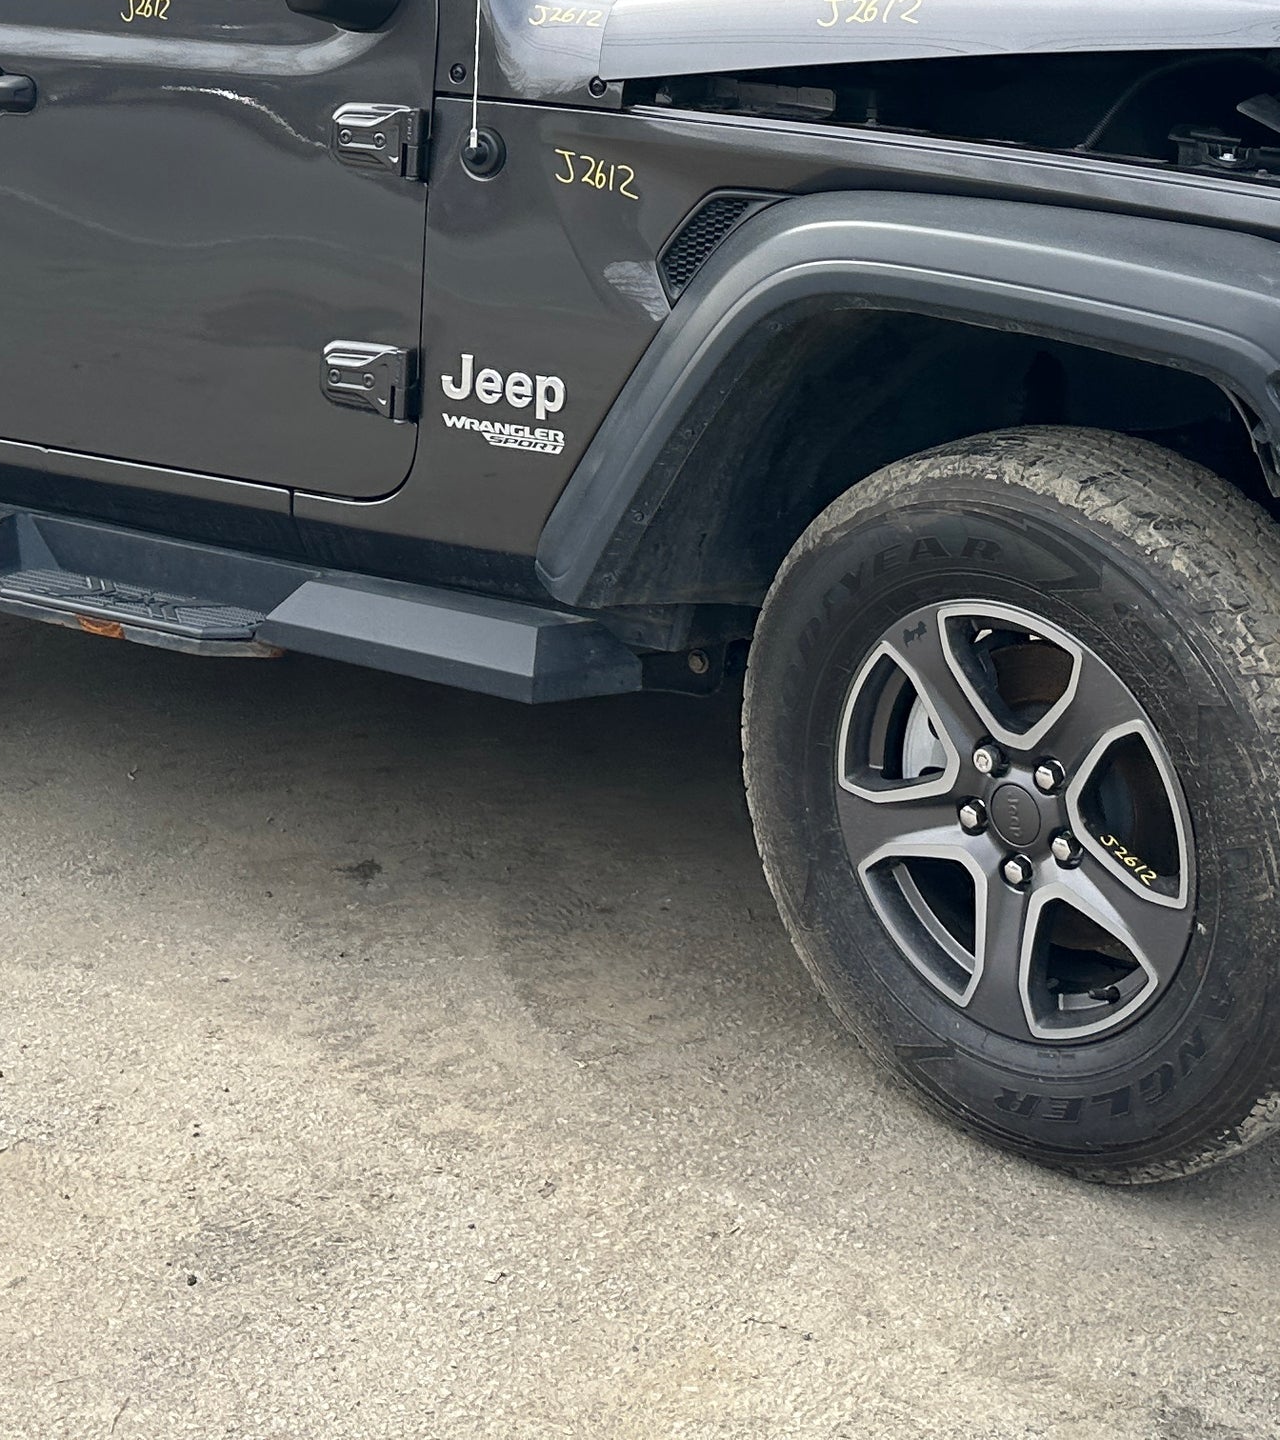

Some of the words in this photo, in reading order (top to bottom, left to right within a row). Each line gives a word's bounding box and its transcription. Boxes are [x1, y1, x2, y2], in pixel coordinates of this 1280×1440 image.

[528, 4, 603, 27] J2612
[554, 148, 639, 200] J2612
[441, 354, 566, 420] Jeep
[442, 413, 565, 444] WRANGLER
[488, 435, 560, 452] SPORT
[1100, 834, 1157, 887] J2612
